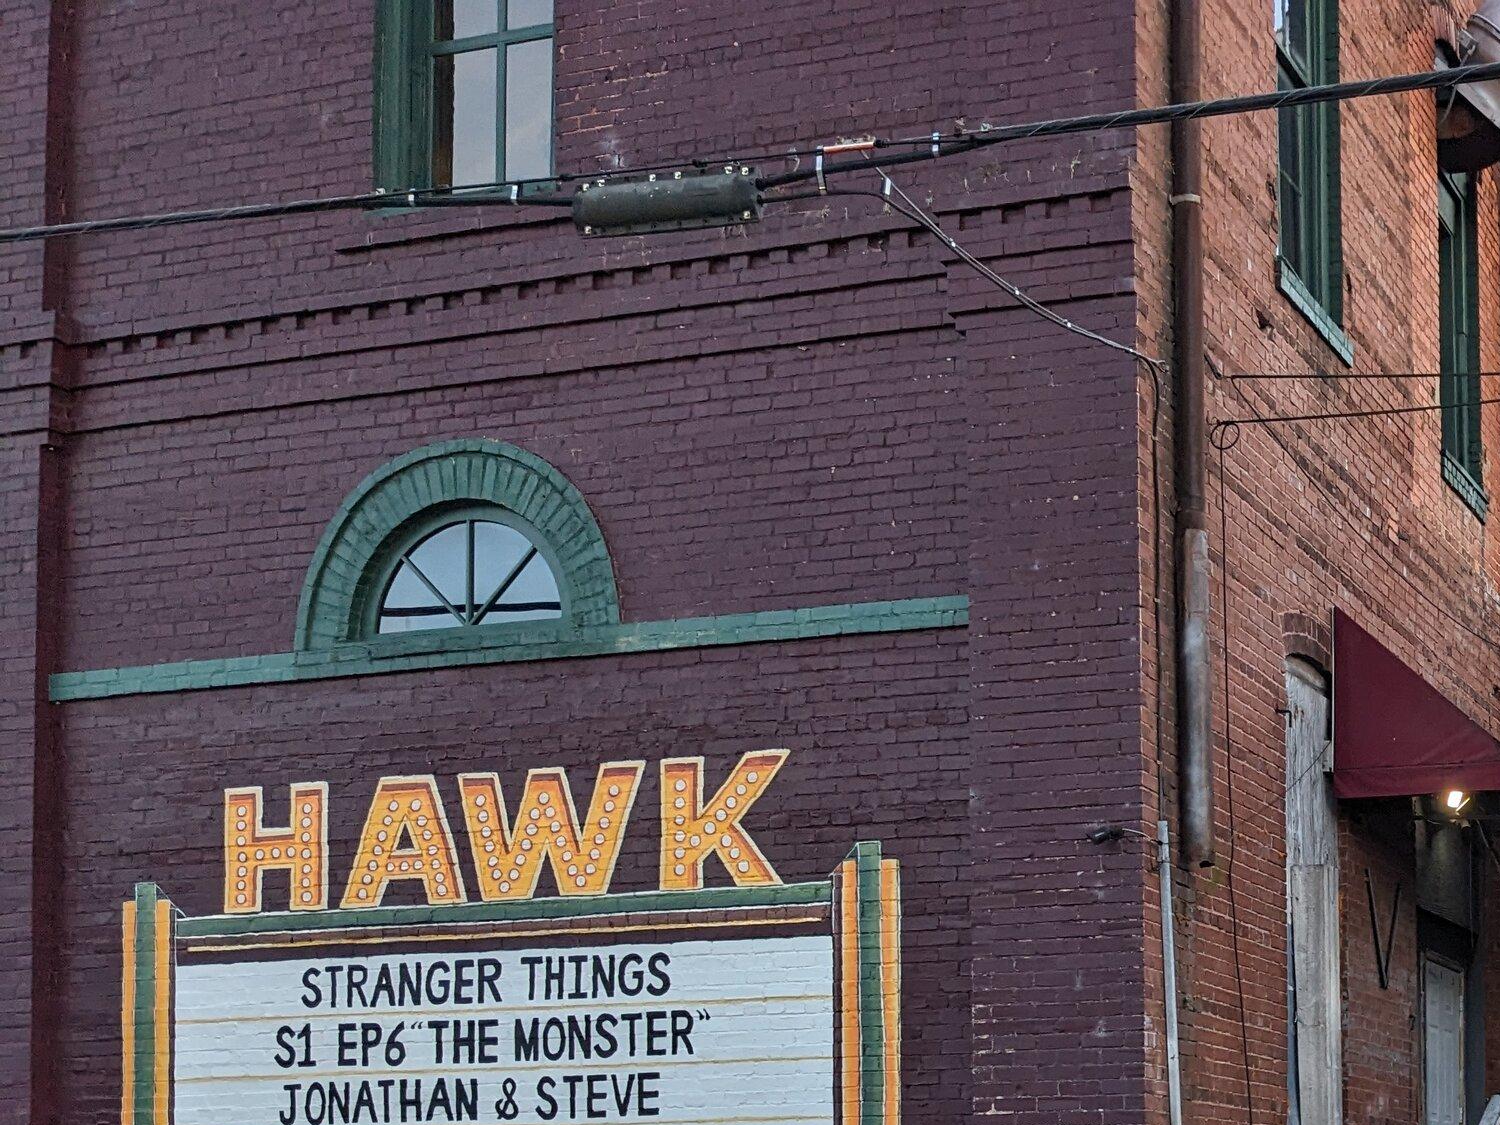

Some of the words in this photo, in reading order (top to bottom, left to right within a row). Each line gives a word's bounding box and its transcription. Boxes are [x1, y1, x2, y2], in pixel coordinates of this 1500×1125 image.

[222, 748, 792, 914] HAWK
[301, 958, 503, 1009] STRANGER
[520, 951, 671, 1001] THINGS
[273, 1023, 317, 1069] S1
[337, 1021, 406, 1068] EP6
[494, 1077, 519, 1121] &
[535, 1072, 661, 1121] STEVE
